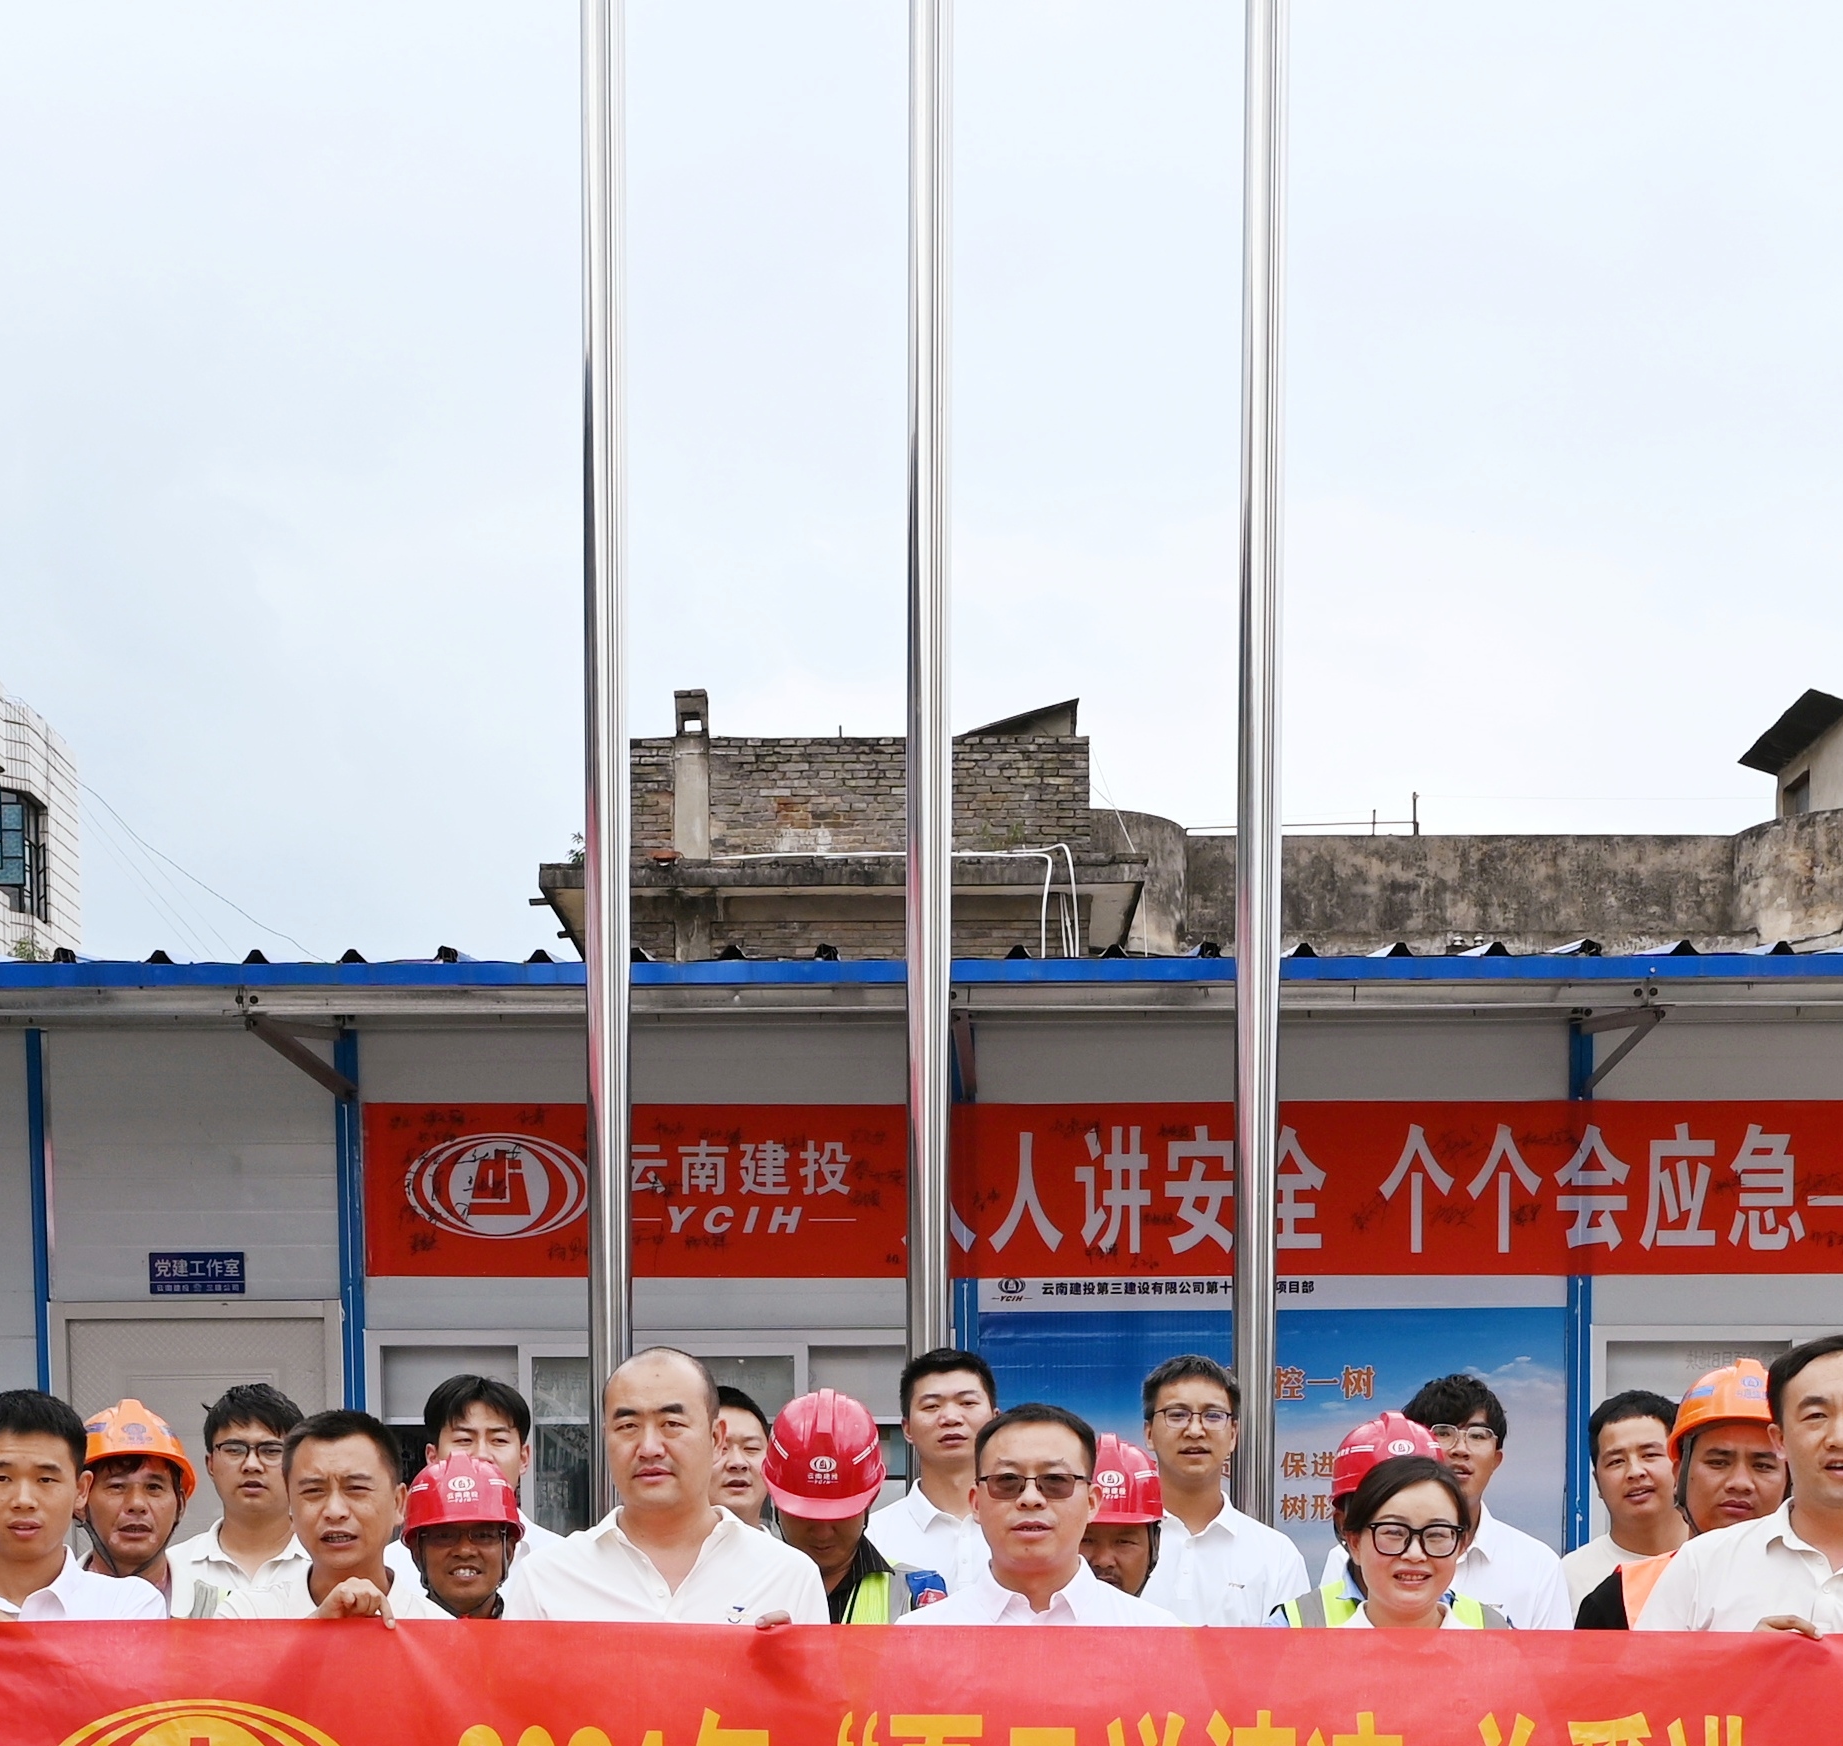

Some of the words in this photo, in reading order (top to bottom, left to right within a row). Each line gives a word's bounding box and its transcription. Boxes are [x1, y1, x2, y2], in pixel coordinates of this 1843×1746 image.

[631, 1140, 852, 1196] 云南建投
[667, 1205, 804, 1235] YCIH
[154, 1258, 240, 1277] 党建工作室
